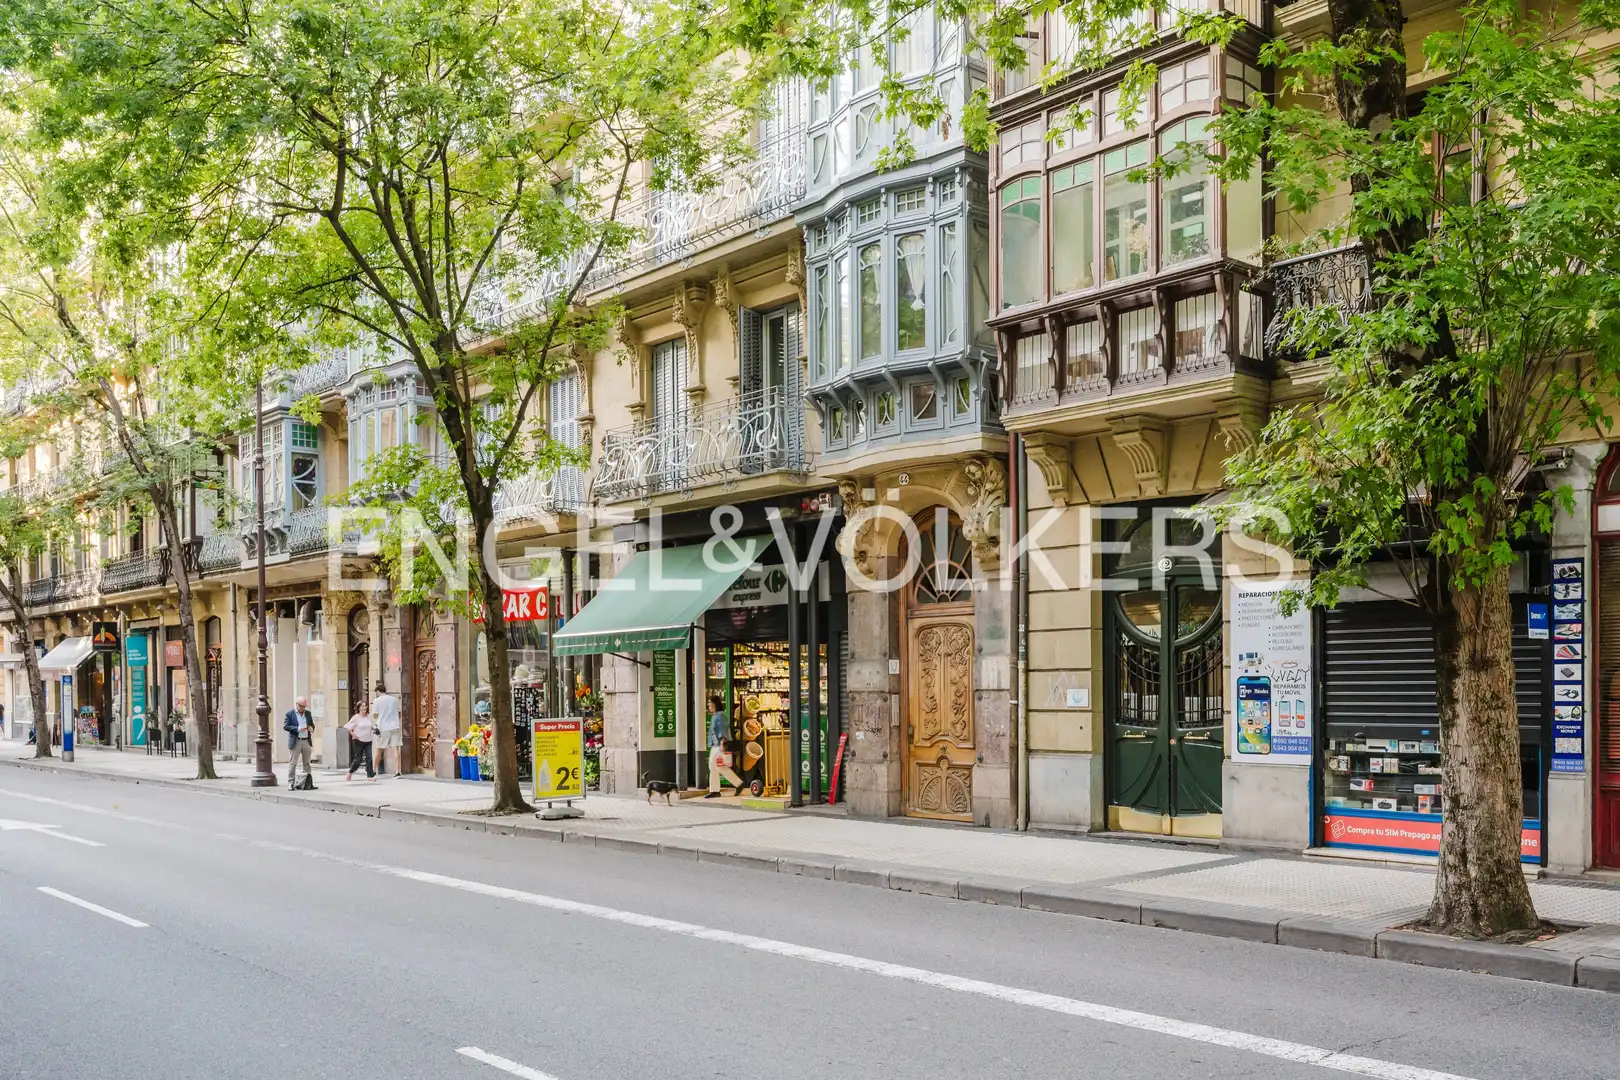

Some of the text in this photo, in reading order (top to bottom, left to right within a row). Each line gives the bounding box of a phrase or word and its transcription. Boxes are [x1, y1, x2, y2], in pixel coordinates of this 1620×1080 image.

[729, 575, 761, 590] efour
[1347, 825, 1374, 836] Compra
[1376, 827, 1384, 836] tu
[1385, 828, 1398, 837] SIM
[1400, 829, 1430, 841] Prepago
